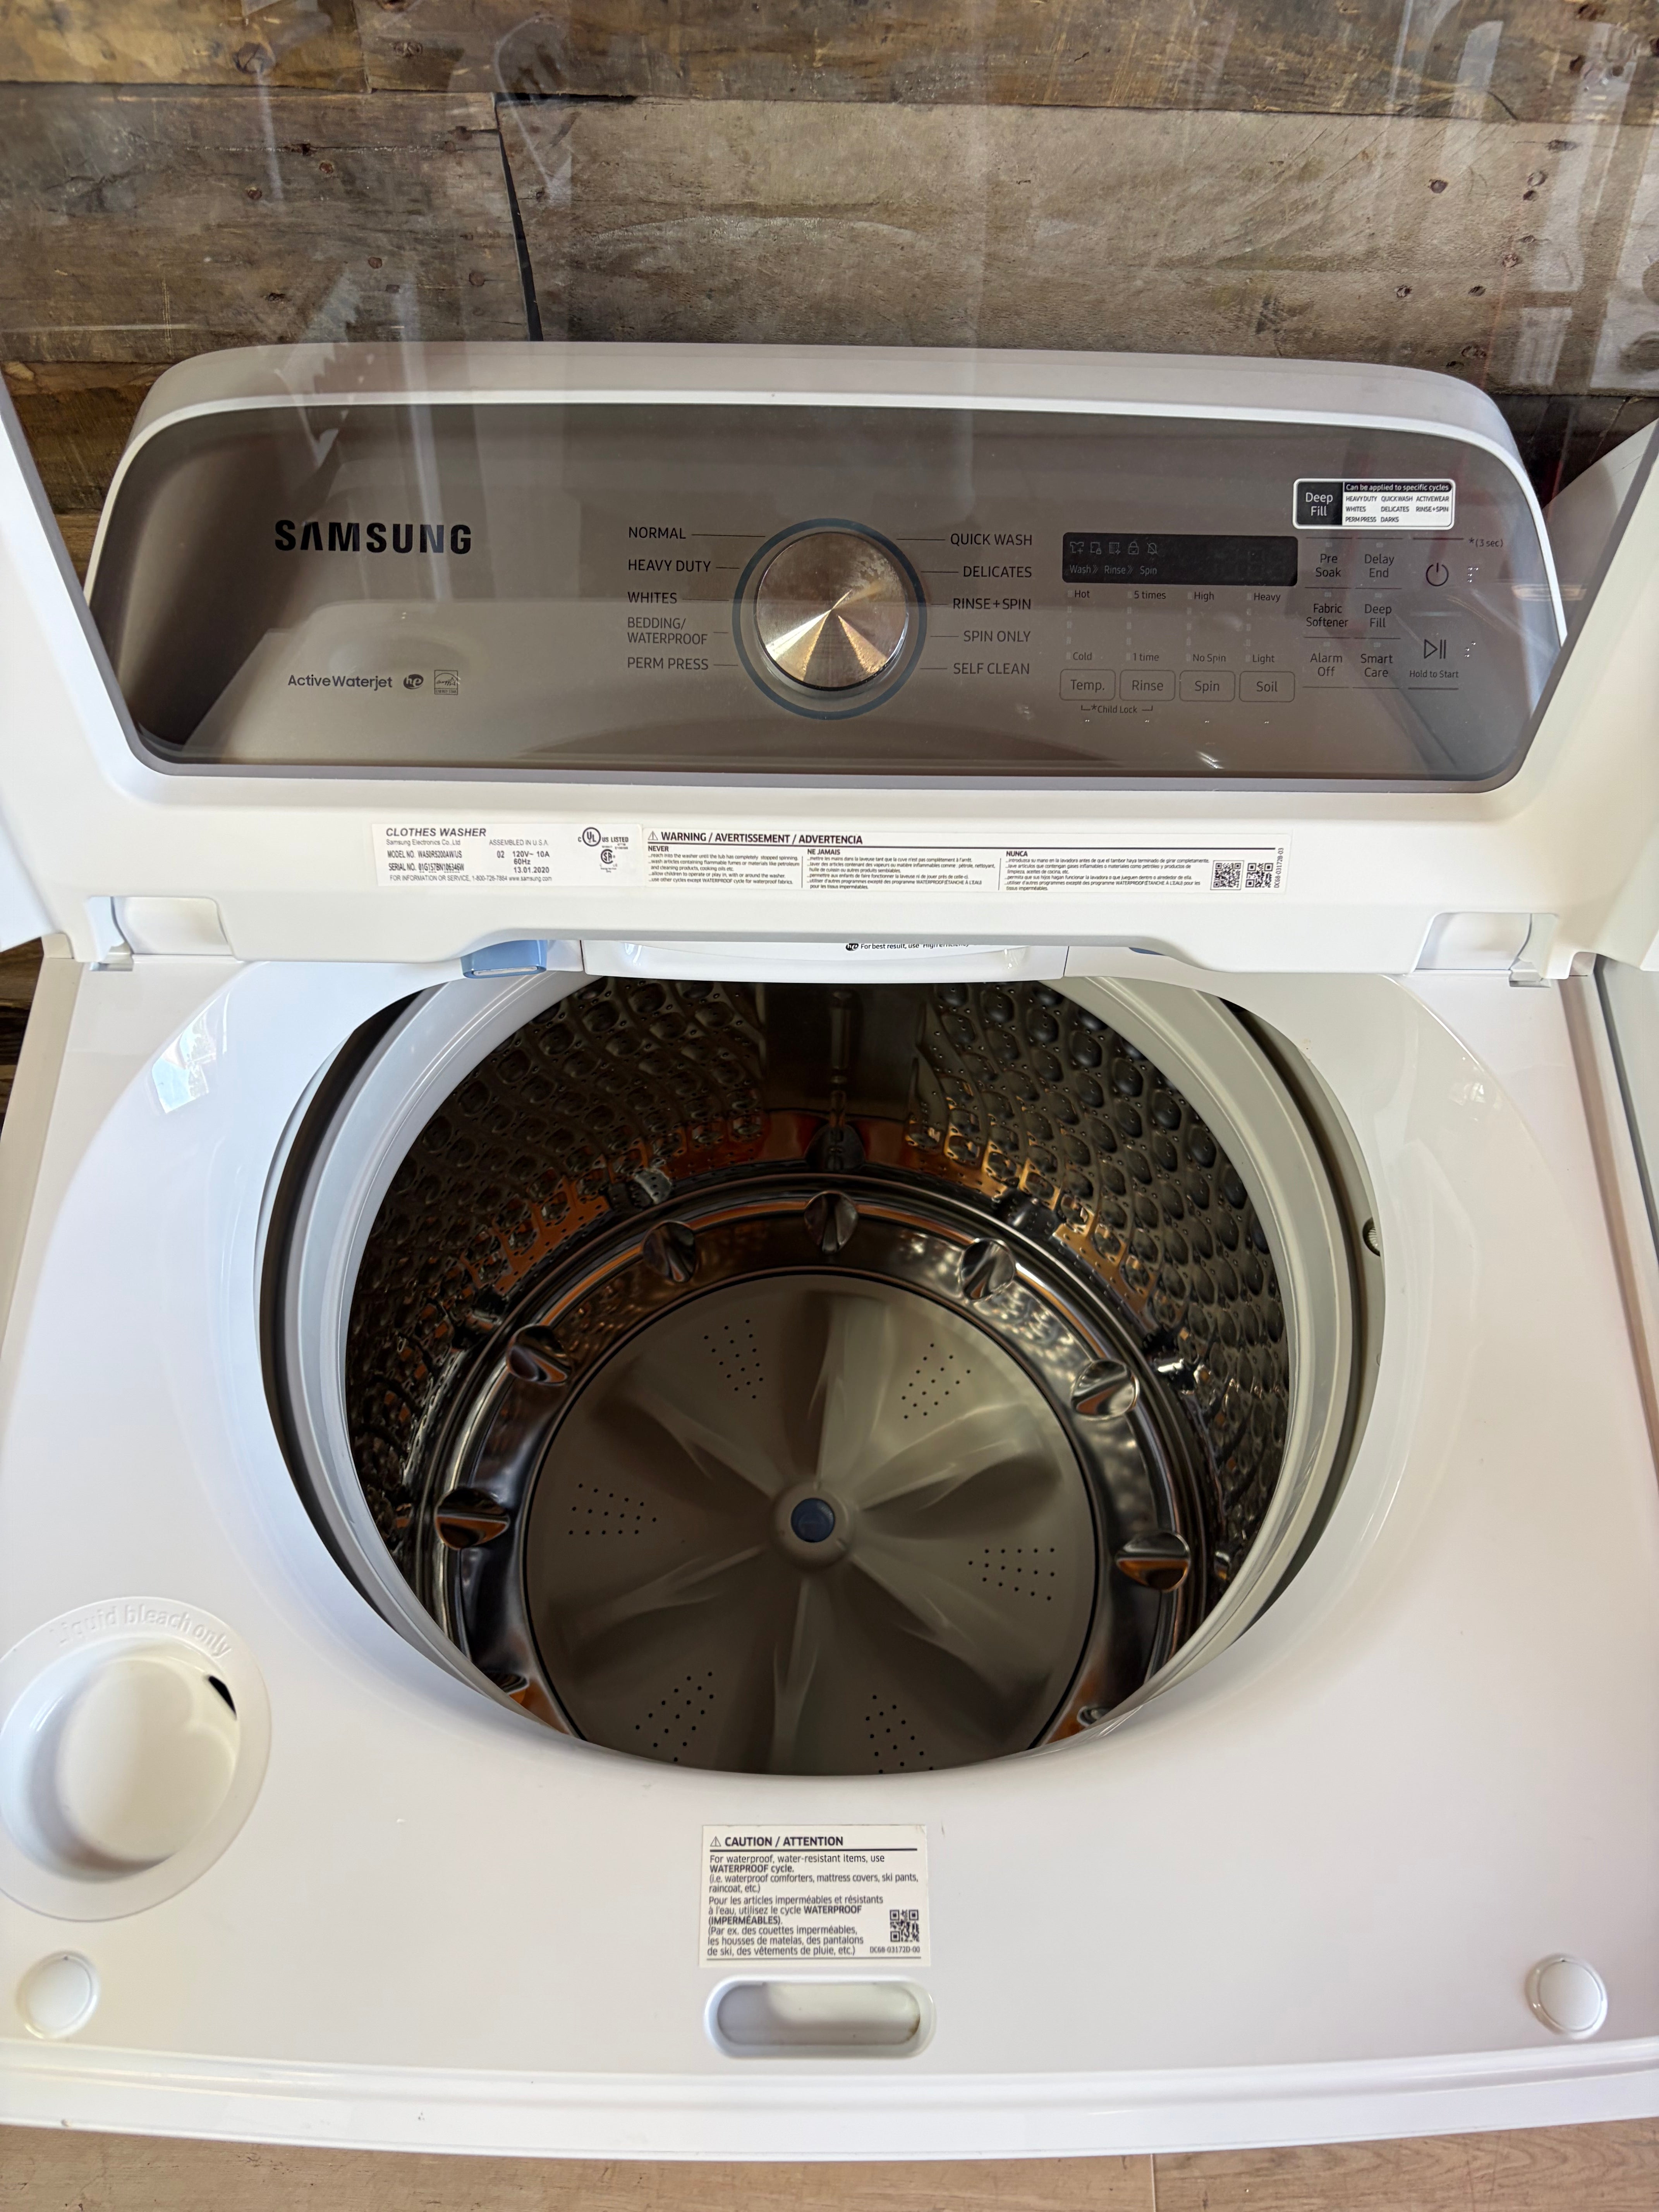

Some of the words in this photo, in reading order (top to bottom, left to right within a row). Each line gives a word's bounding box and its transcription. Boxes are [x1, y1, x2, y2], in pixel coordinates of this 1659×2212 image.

[1305, 492, 1333, 505] Deep
[1311, 505, 1327, 516] Fill
[275, 520, 471, 554] SAMSUNG
[629, 526, 686, 539] NORMAL
[950, 533, 991, 547] QUICK
[994, 534, 1032, 546] WASH
[1486, 539, 1503, 548] sec)
[1320, 553, 1338, 563] Pre
[1364, 553, 1395, 567] Delay
[629, 559, 672, 571] HEAVY
[676, 560, 711, 572] DUTY
[1070, 564, 1091, 574] Wash
[1104, 565, 1126, 574] Rinse
[1140, 565, 1157, 577] Spin
[963, 566, 1032, 578] DELICATES
[1316, 567, 1341, 577] Soak
[1369, 567, 1389, 578] End
[627, 591, 677, 604] WHITES
[1075, 590, 1090, 598] Hot
[1134, 590, 1139, 599] 5
[1142, 591, 1166, 599] times
[1194, 591, 1214, 602] High
[1254, 592, 1281, 603] Heavy
[1314, 603, 1342, 613] Fabric
[1364, 604, 1392, 617] Deep
[628, 617, 686, 630] BEDDING/
[1306, 616, 1349, 627] Softener
[1370, 617, 1386, 628] Fill
[627, 632, 708, 645] WATERPROOF
[963, 630, 993, 642] SPIN
[997, 630, 1031, 642] ONLY
[1073, 652, 1092, 661] Cold
[1139, 653, 1159, 661] time
[1193, 653, 1205, 662] No
[1207, 653, 1226, 664] Spin
[1252, 654, 1275, 665] Light
[1310, 652, 1343, 663] Alarm
[1360, 653, 1393, 664] Smart
[627, 657, 663, 669] PERM
[668, 658, 709, 670] PRESS
[953, 663, 984, 674] SELF
[987, 663, 1029, 675] CLEAN
[1317, 666, 1335, 677] Off
[1364, 667, 1389, 677] Care
[1409, 670, 1427, 678] Hold
[1439, 670, 1459, 678] Start
[288, 674, 331, 687] Active
[332, 675, 393, 691] Waterjet
[1070, 679, 1105, 693] Temp.
[1132, 680, 1164, 691] Rinse
[1194, 680, 1219, 694] Spin
[1256, 681, 1278, 692] Soil
[1120, 705, 1137, 714] Lock
[386, 828, 436, 836] CLOTHES
[440, 828, 486, 836] WASHER
[386, 839, 411, 847] Samsung
[661, 831, 706, 842] WARNING
[708, 832, 713, 843] /
[715, 833, 790, 843] AVERTISSEMENT
[792, 834, 797, 845] /
[799, 835, 863, 844] ADVERTENCIA
[387, 850, 406, 858] MODEL
[496, 850, 505, 859] 02
[388, 863, 406, 871] SERIAL
[407, 863, 417, 871] NO.
[125, 1604, 192, 1633] bleach
[194, 1624, 232, 1659] only
[725, 1836, 772, 1847] CAUTION
[775, 1836, 780, 1848] /
[783, 1836, 843, 1846] ATTENTION
[710, 1855, 724, 1863] For
[726, 1854, 775, 1864] waterproof,
[777, 1854, 840, 1863] water-resistant
[843, 1854, 868, 1863] items,
[709, 1864, 769, 1873] WATERPROOF
[771, 1864, 794, 1874] cycle.
[725, 1873, 768, 1884] waterproof
[770, 1874, 814, 1883] comforters,
[817, 1874, 851, 1882] mattress
[852, 1874, 880, 1882] covers,
[882, 1873, 893, 1882] ski
[895, 1873, 918, 1883] pants,
[709, 1884, 742, 1893] raincoat,
[709, 1896, 728, 1905] Pour
[730, 1896, 742, 1905] les
[744, 1895, 773, 1905] articles
[775, 1895, 832, 1906] imperméables
[834, 1895, 842, 1904] et
[845, 1895, 883, 1904] résistants
[708, 1905, 713, 1915] à
[738, 1905, 768, 1915] utilisez
[771, 1905, 778, 1915] le
[780, 1905, 801, 1916] cycle
[804, 1905, 862, 1914] WATERPROOF
